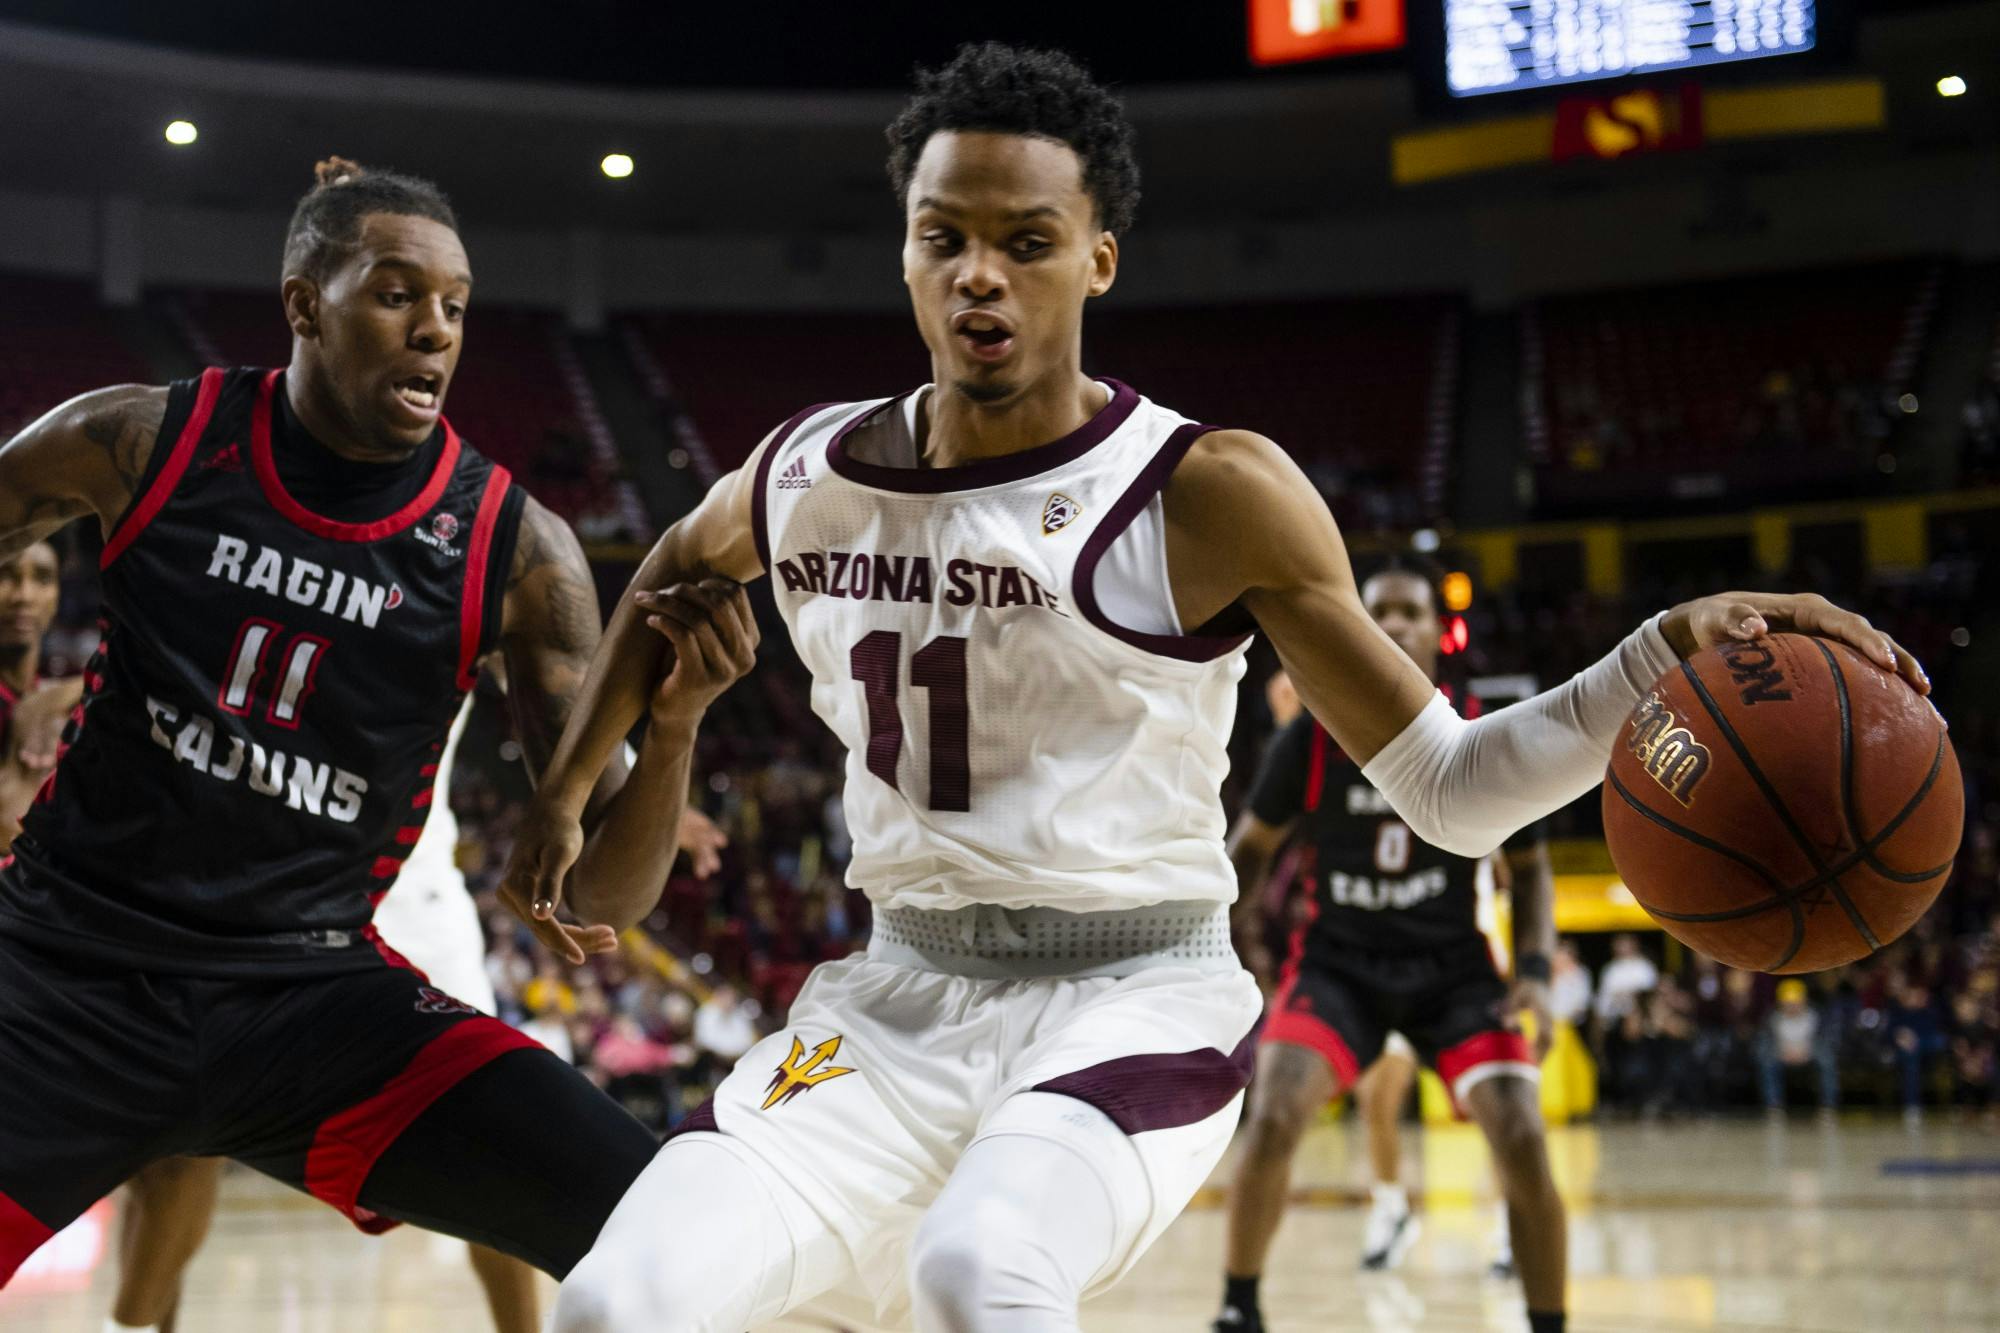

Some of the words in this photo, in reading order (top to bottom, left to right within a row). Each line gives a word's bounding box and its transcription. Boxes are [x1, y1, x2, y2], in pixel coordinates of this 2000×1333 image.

[775, 551, 932, 603] ARZONA
[217, 616, 333, 731] 11
[850, 630, 970, 812] 11
